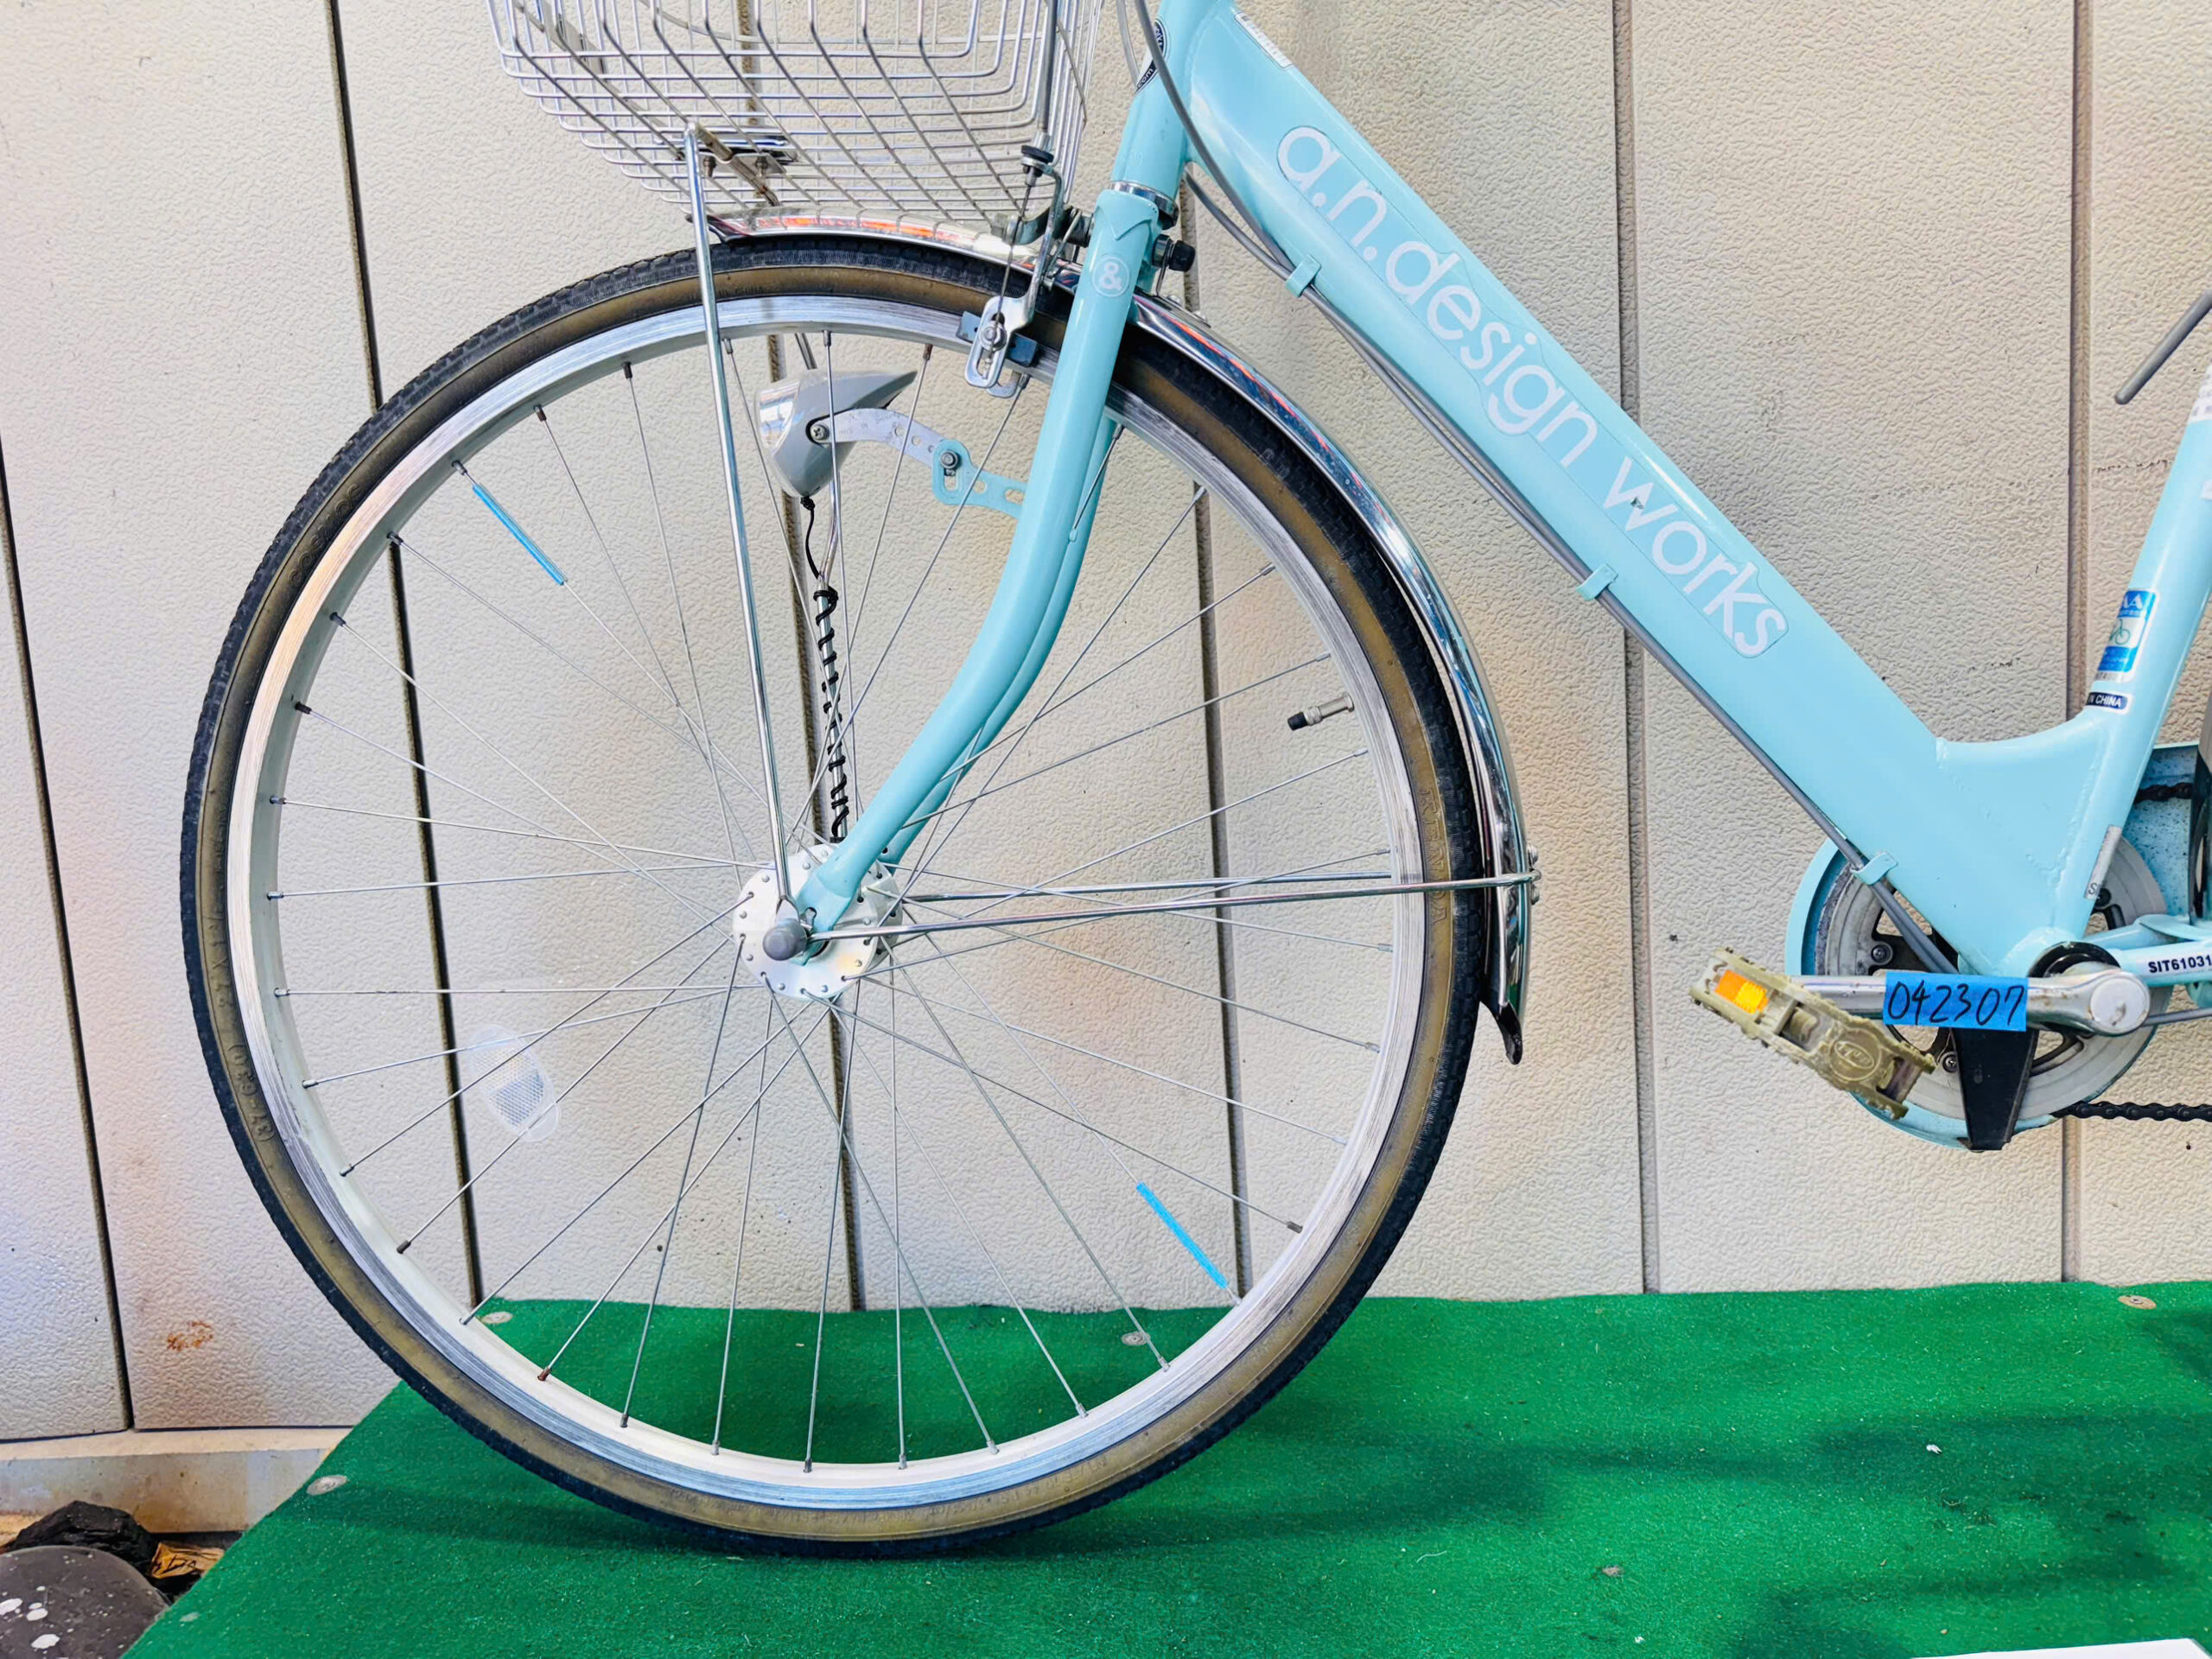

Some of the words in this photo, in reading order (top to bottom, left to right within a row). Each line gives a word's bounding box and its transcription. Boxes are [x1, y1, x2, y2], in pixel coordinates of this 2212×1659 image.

[1099, 262, 1122, 290] &
[1278, 126, 1598, 467] a.n.design
[1603, 456, 1786, 655] works
[2095, 695, 2122, 708] CHINA
[1888, 980, 2024, 1027] 042307
